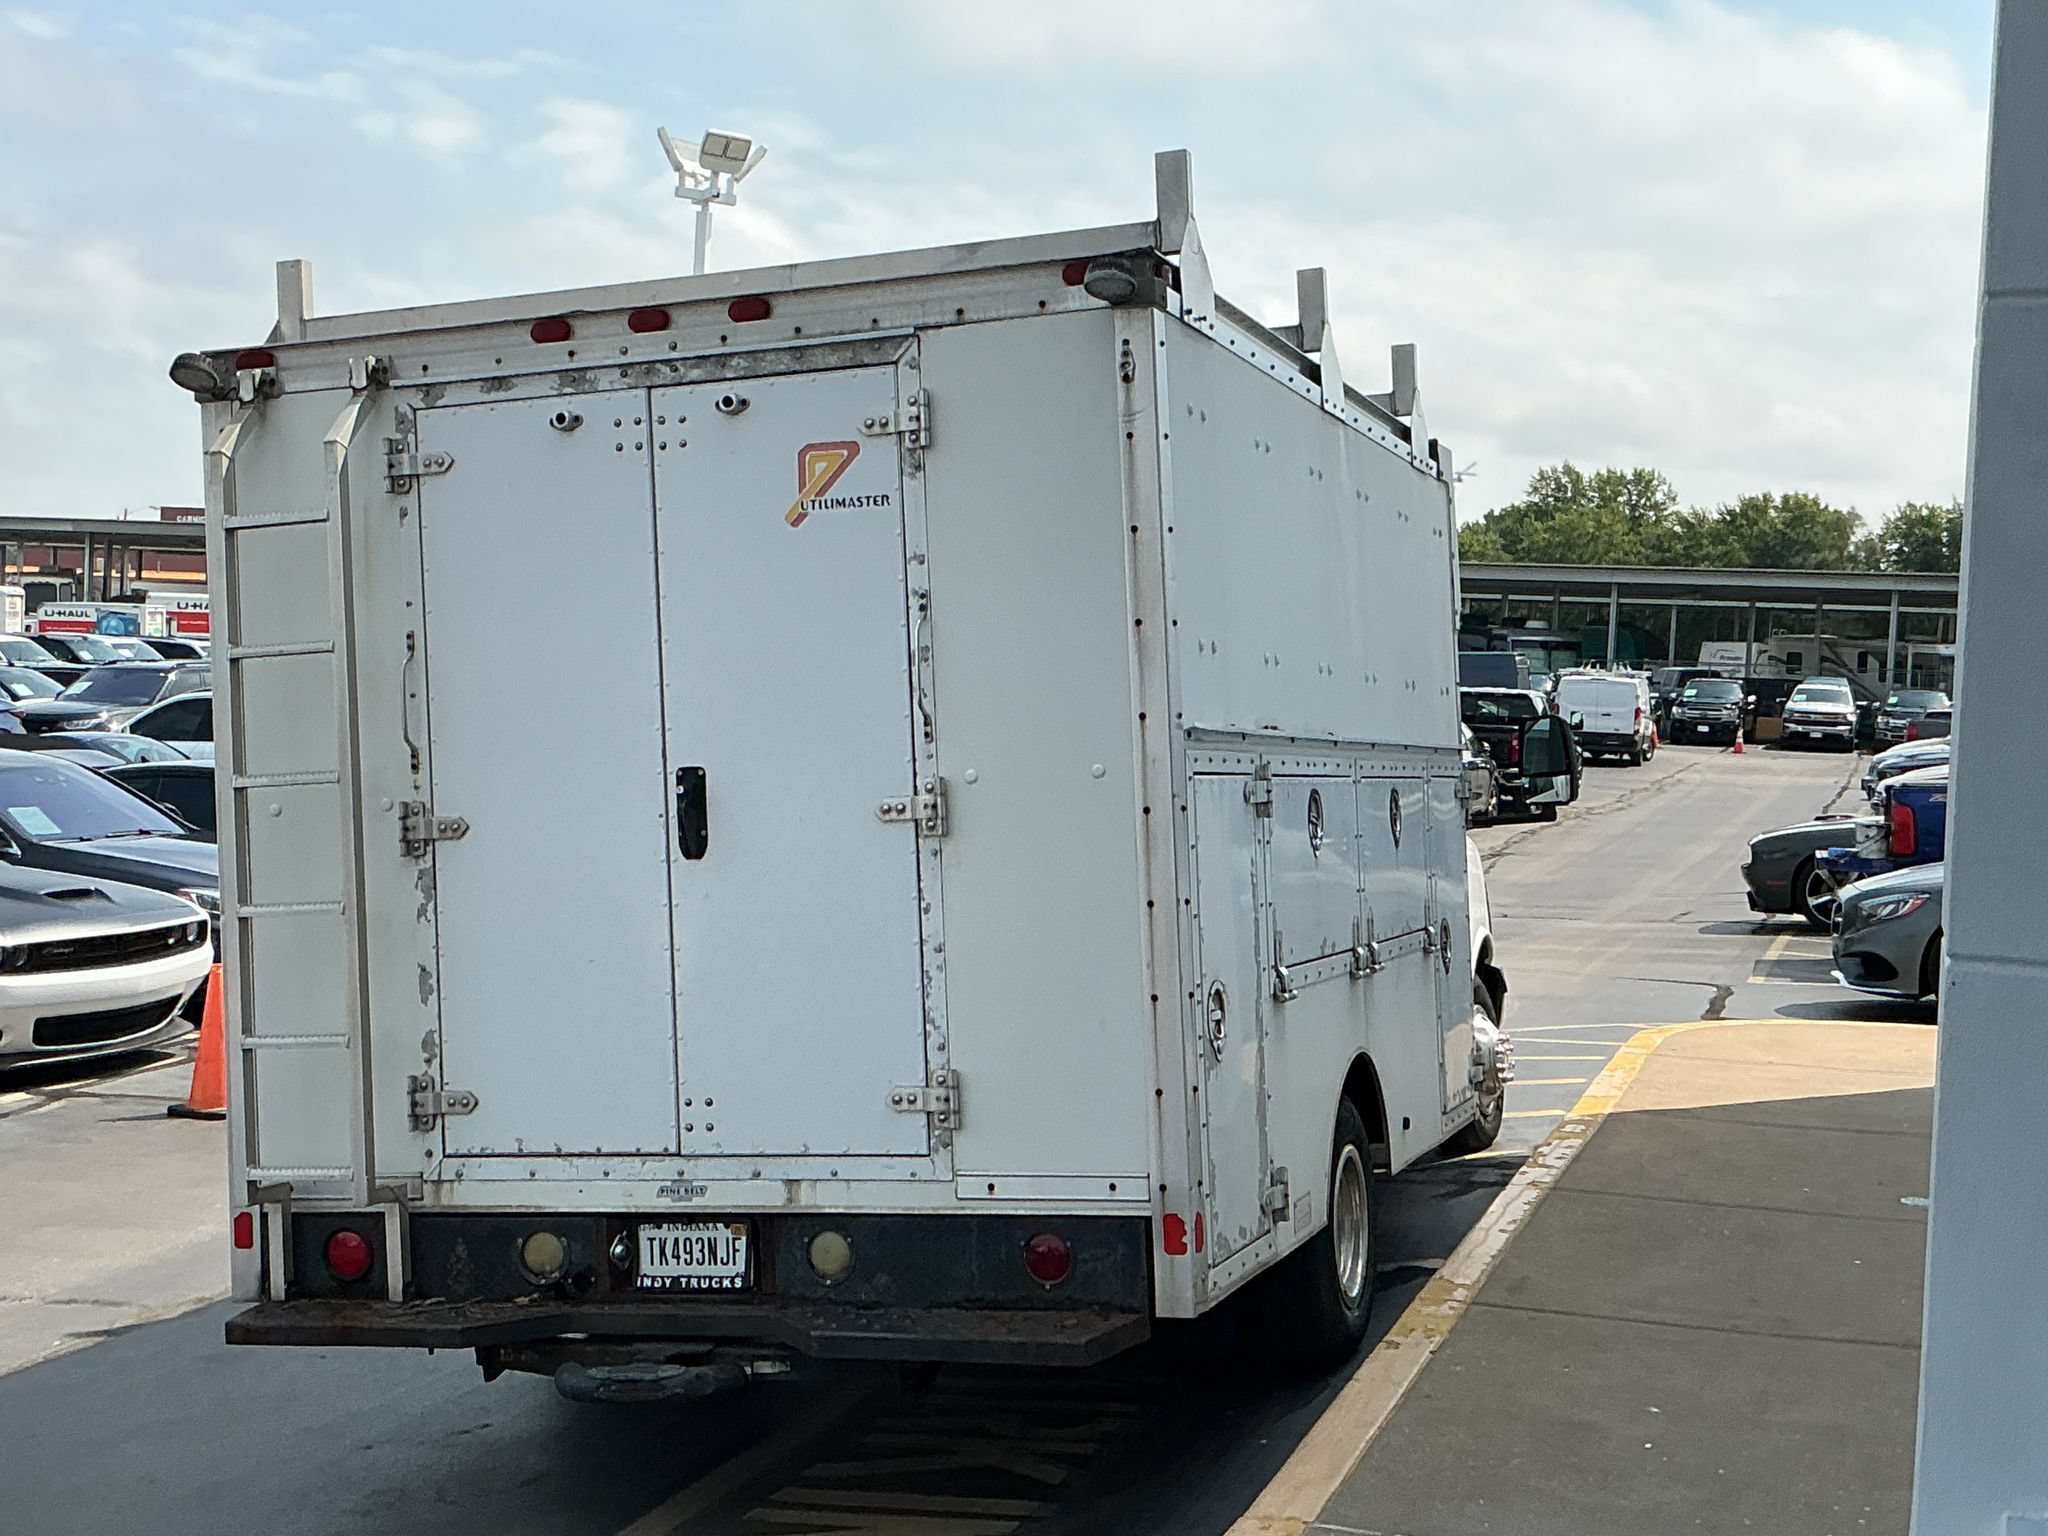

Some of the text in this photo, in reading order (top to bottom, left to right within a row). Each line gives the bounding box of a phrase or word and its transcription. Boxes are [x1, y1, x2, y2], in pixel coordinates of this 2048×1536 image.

[801, 495, 890, 511] UTILIMASTER
[44, 609, 91, 618] U-HAUL
[666, 1223, 719, 1232] INDIANA
[646, 1236, 742, 1267] TK493NJF
[636, 1276, 743, 1289] INDY TRUCKS
